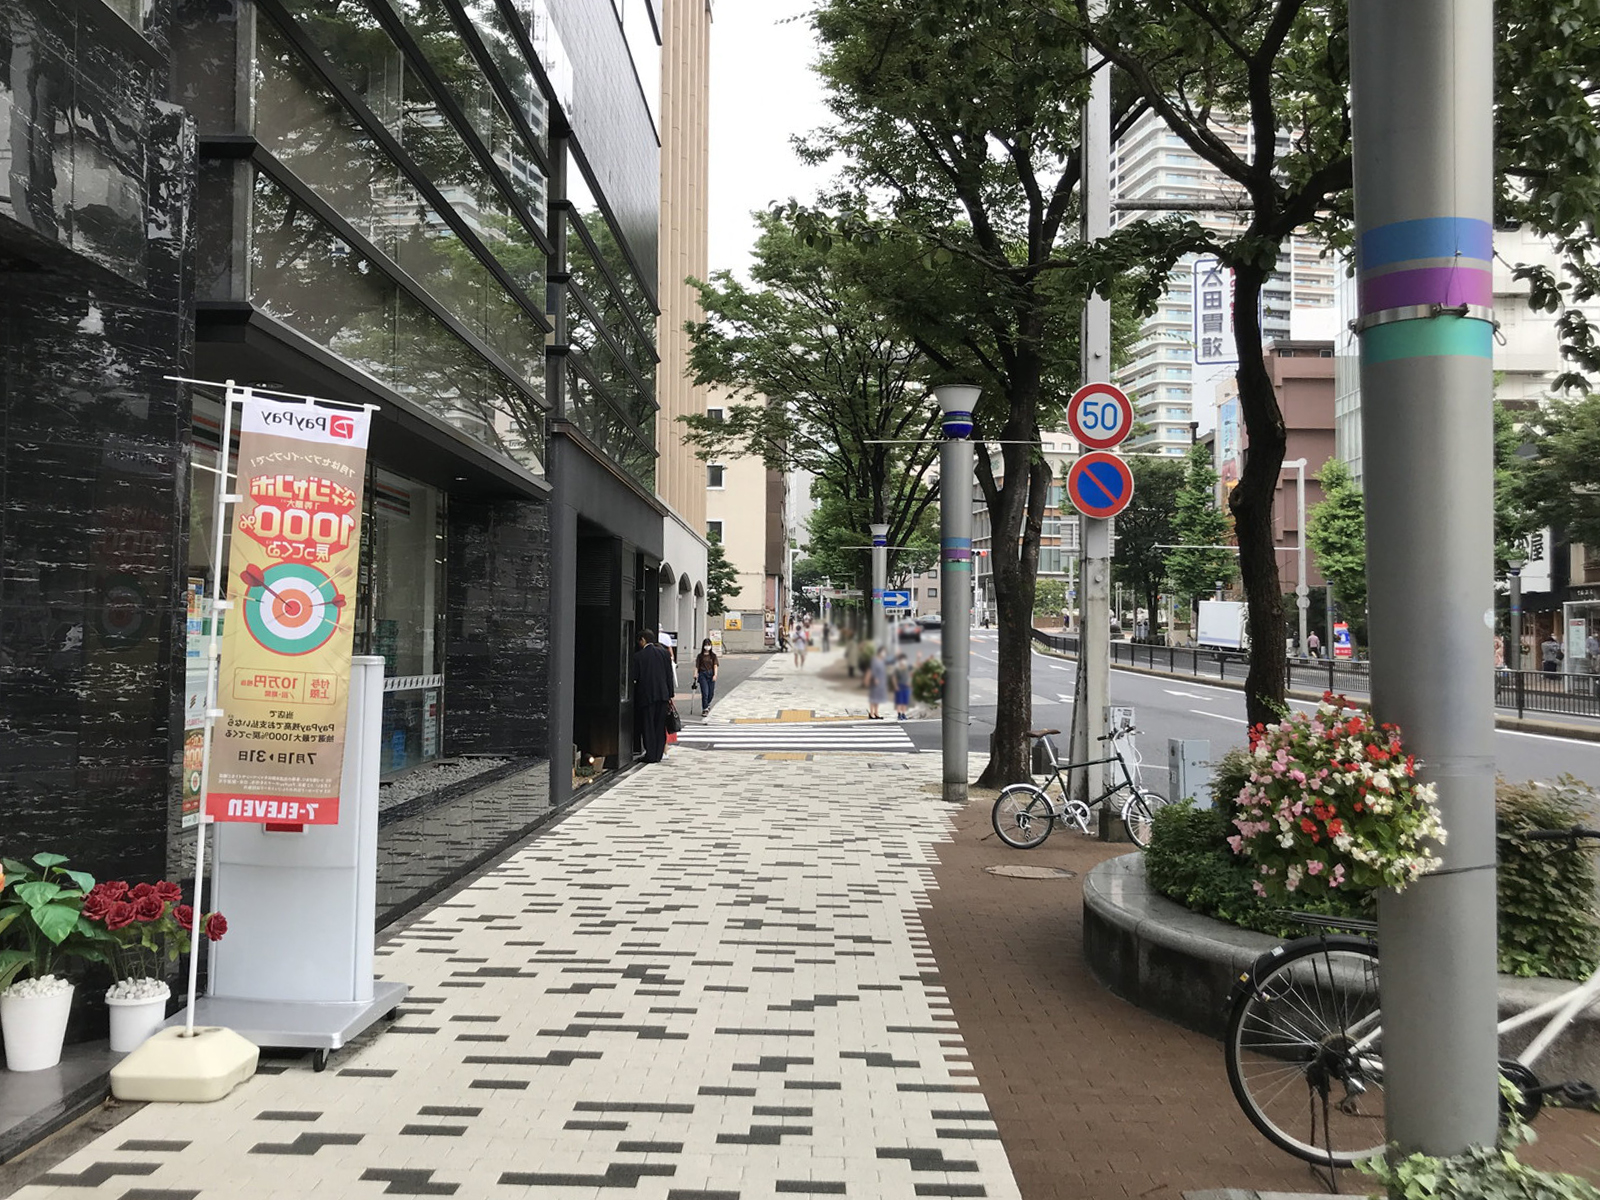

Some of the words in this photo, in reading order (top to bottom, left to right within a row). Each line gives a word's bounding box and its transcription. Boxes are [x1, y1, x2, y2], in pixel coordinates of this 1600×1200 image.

[1202, 267, 1223, 358] 太田胃散
[1081, 400, 1118, 432] 50
